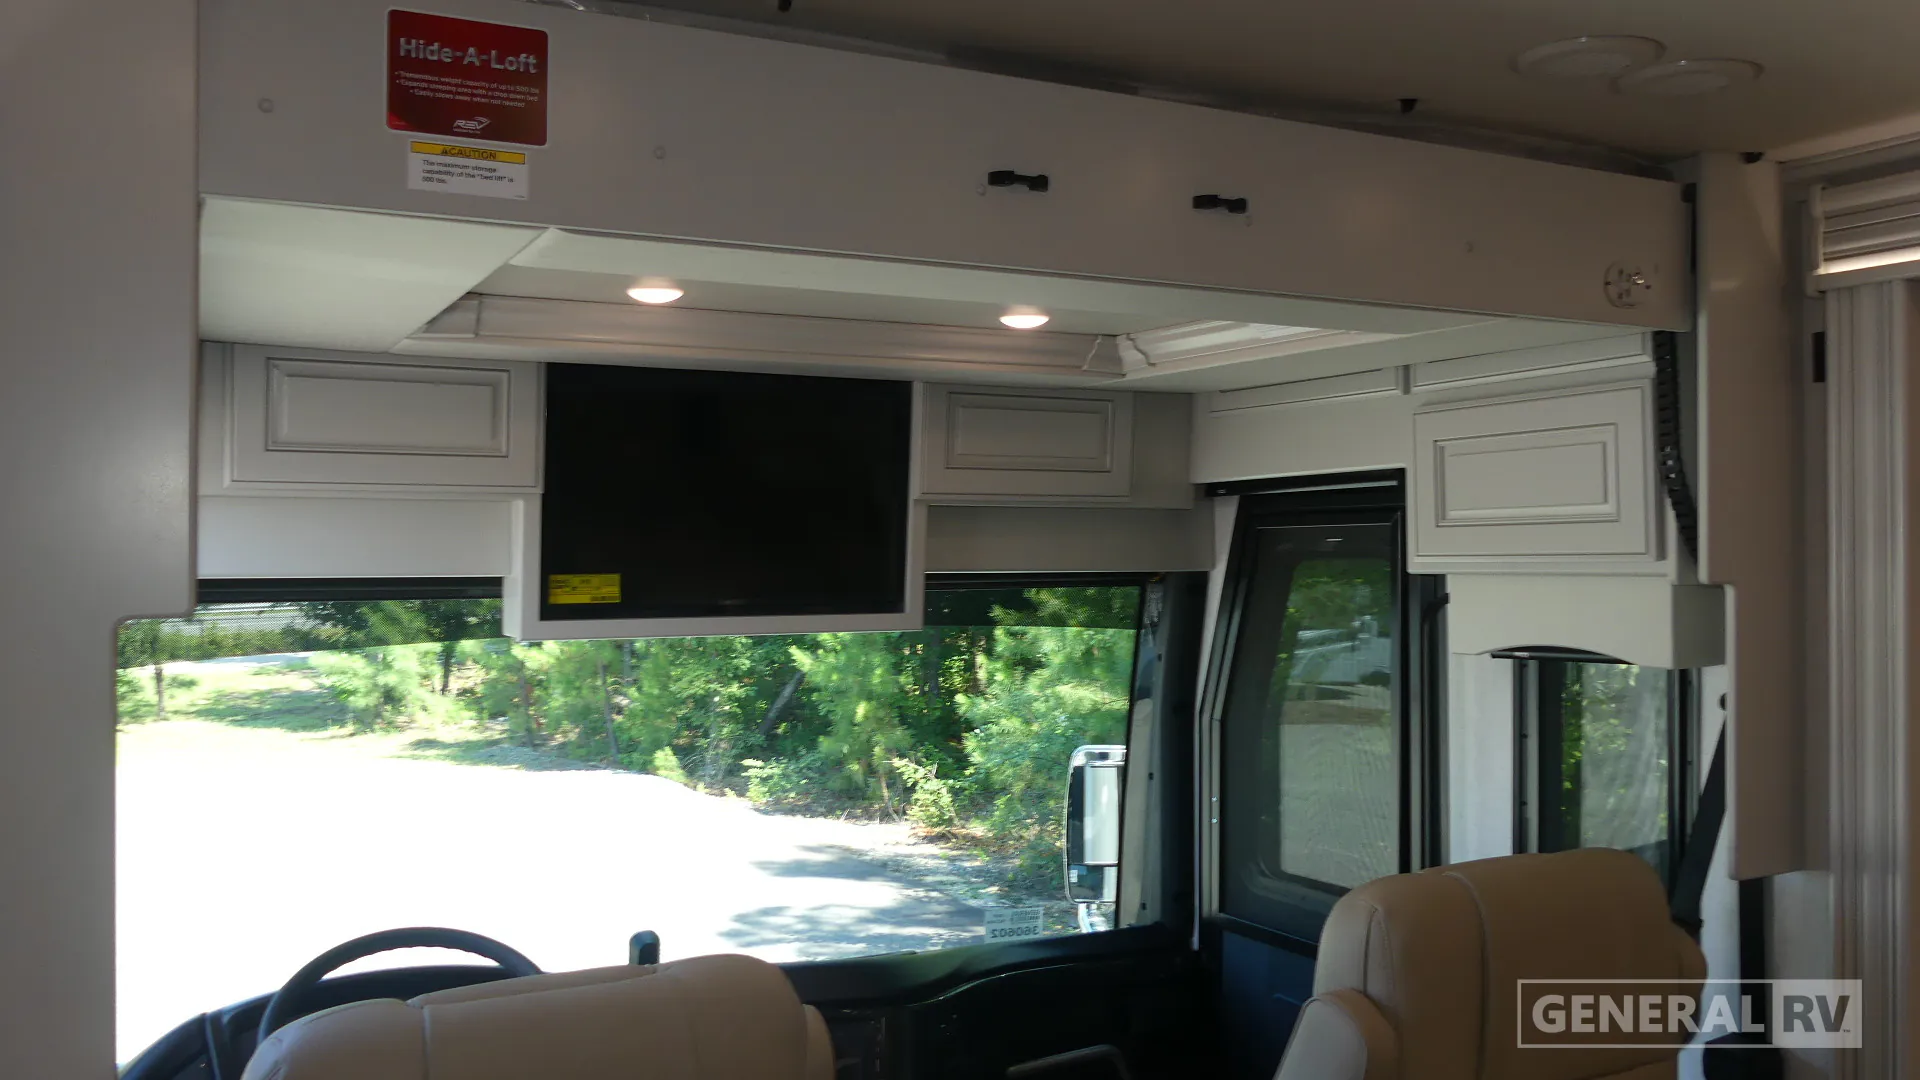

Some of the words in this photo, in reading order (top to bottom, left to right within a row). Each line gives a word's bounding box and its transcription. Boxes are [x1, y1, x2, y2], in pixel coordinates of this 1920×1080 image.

[400, 37, 537, 74] Hide-A-Loft
[430, 83, 456, 92] sleeping
[441, 76, 462, 85] weight
[463, 79, 489, 89] capacity
[414, 88, 434, 97] Easily
[502, 100, 525, 108] needed
[453, 117, 491, 130] REV
[448, 148, 497, 160] CAUTION
[422, 168, 454, 178] capability
[436, 161, 470, 170] maximum
[471, 163, 497, 173] storage
